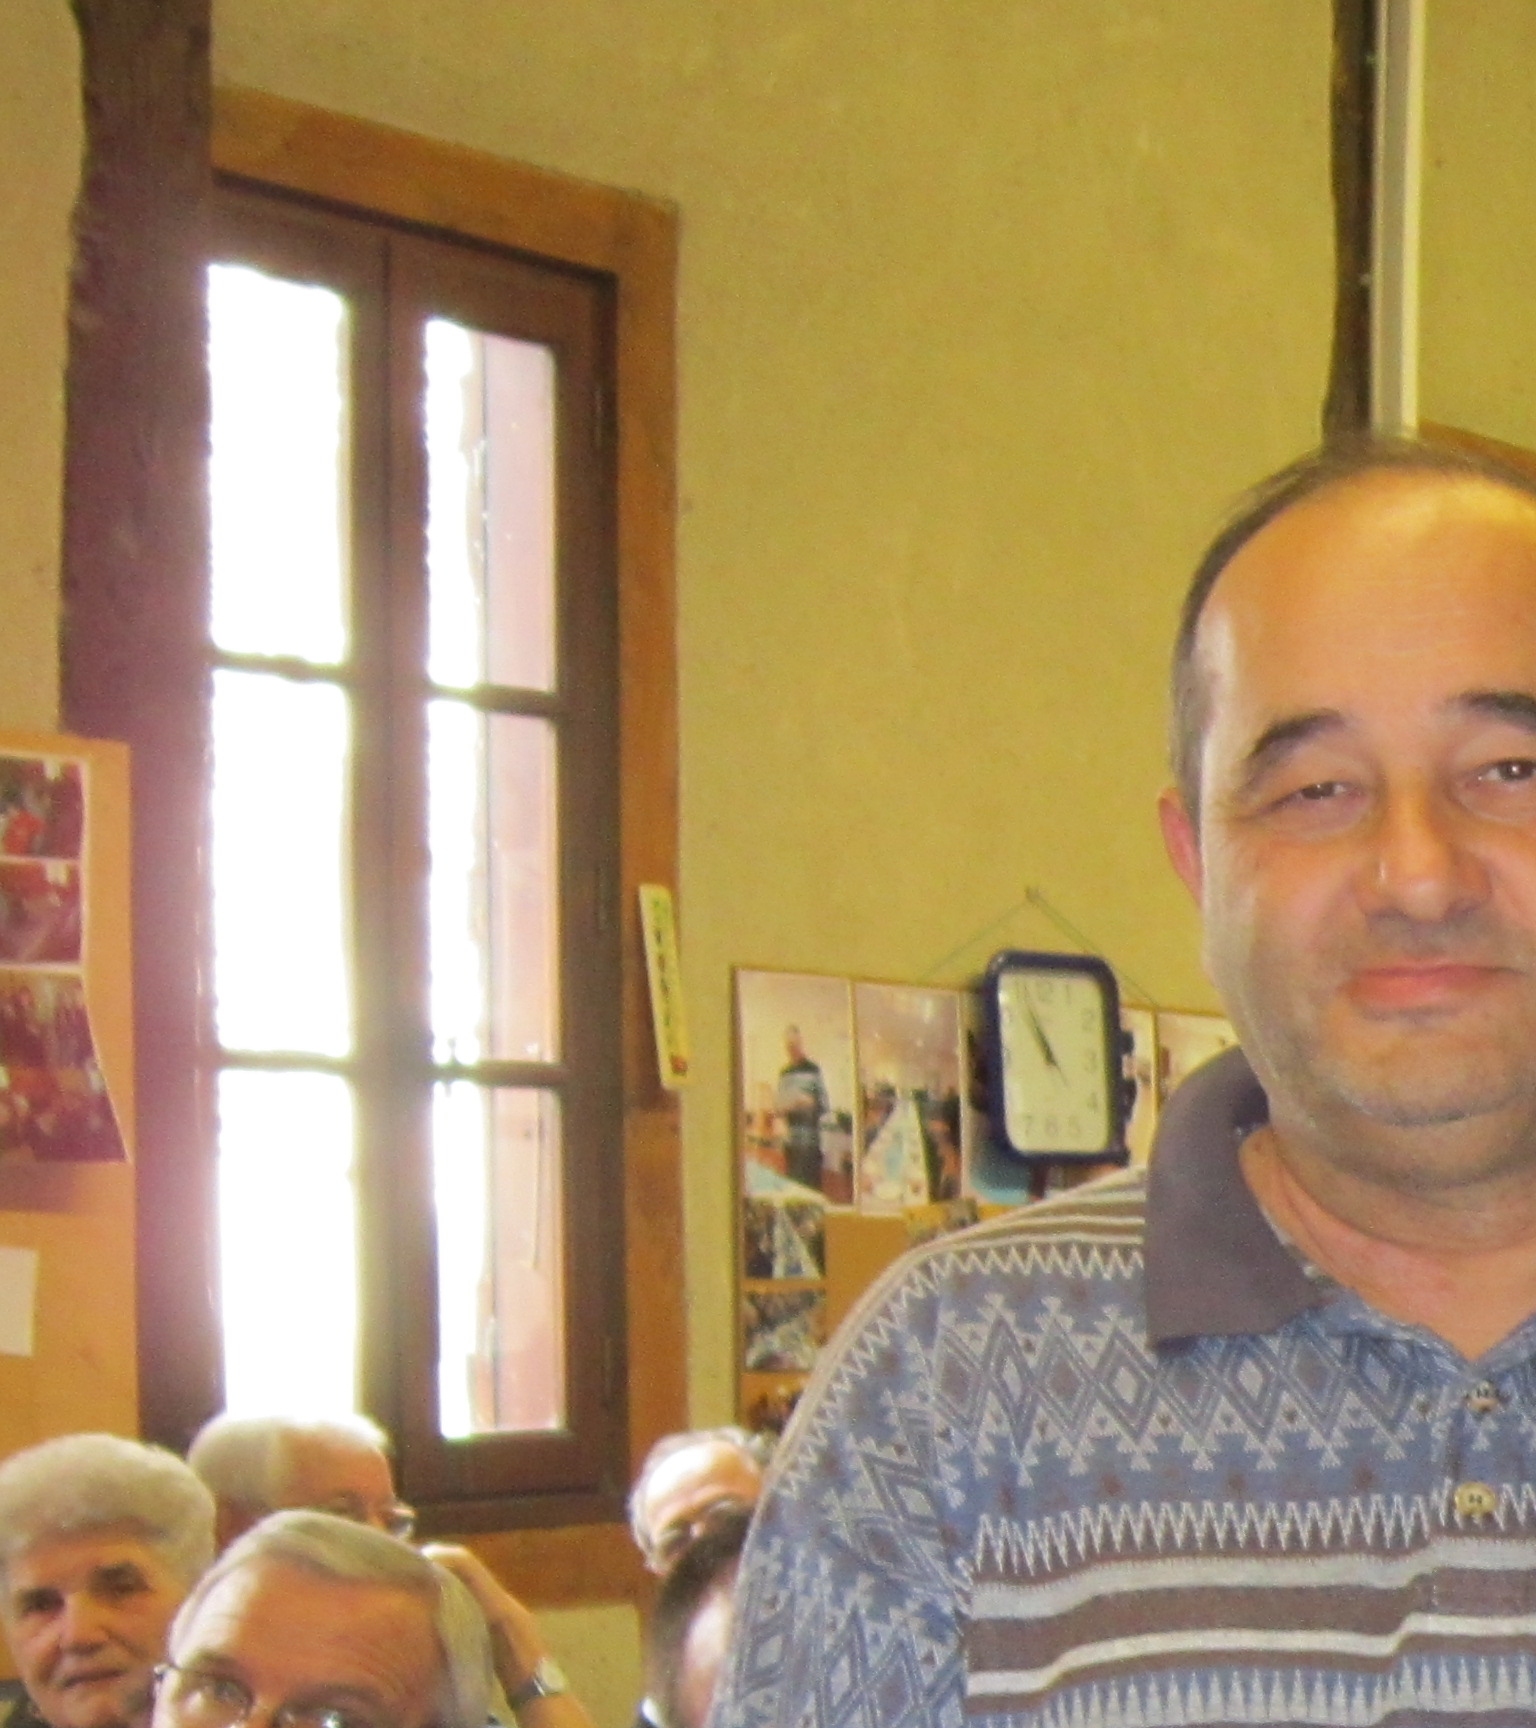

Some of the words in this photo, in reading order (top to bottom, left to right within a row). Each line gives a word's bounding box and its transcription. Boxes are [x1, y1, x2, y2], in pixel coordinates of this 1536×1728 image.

[1036, 982, 1054, 1004] 12
[1080, 1008, 1095, 1032] 2
[1083, 1049, 1099, 1072] 3
[1086, 1091, 1099, 1113] 4
[1022, 1114, 1035, 1136] 7
[1043, 1114, 1059, 1136] 6
[1067, 1113, 1082, 1136] 5
